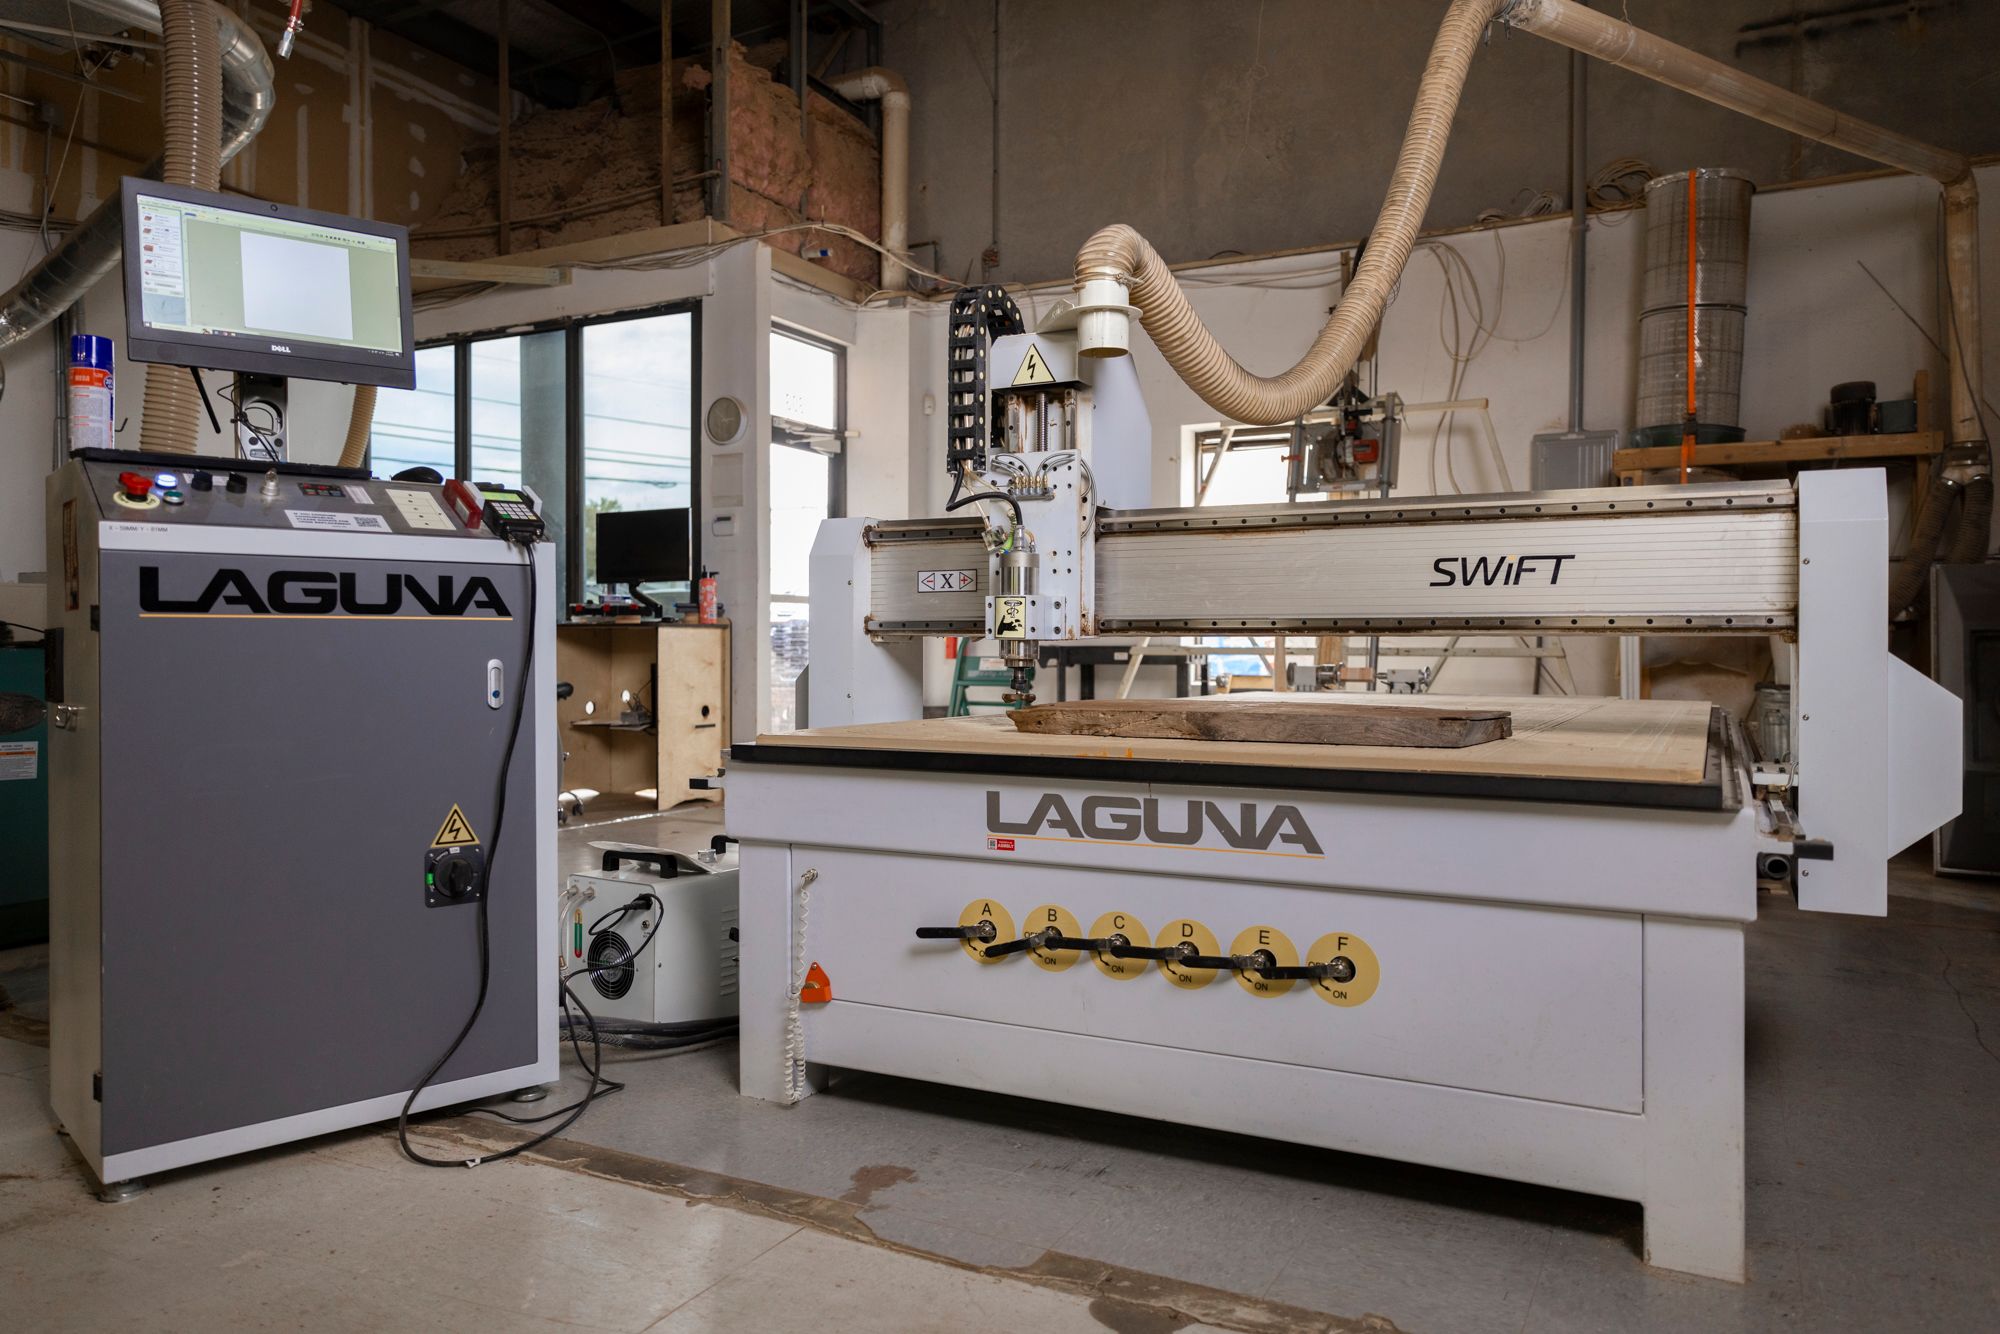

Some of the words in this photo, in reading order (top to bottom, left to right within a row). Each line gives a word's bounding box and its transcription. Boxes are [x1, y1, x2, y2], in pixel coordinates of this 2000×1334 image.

[271, 345, 291, 353] DELL
[940, 573, 954, 589] X
[139, 566, 512, 617] LAGUNA
[986, 790, 1325, 855] LAGUNA
[981, 902, 992, 917] A
[1048, 908, 1058, 922] B
[1113, 915, 1125, 930] C
[1182, 923, 1194, 938] D
[1259, 929, 1270, 945] E
[1337, 936, 1349, 951] F
[1044, 956, 1057, 965] ON
[1111, 965, 1124, 973] ON
[1179, 974, 1192, 983] ON
[1254, 982, 1268, 991] ON
[1333, 990, 1347, 999] ON
